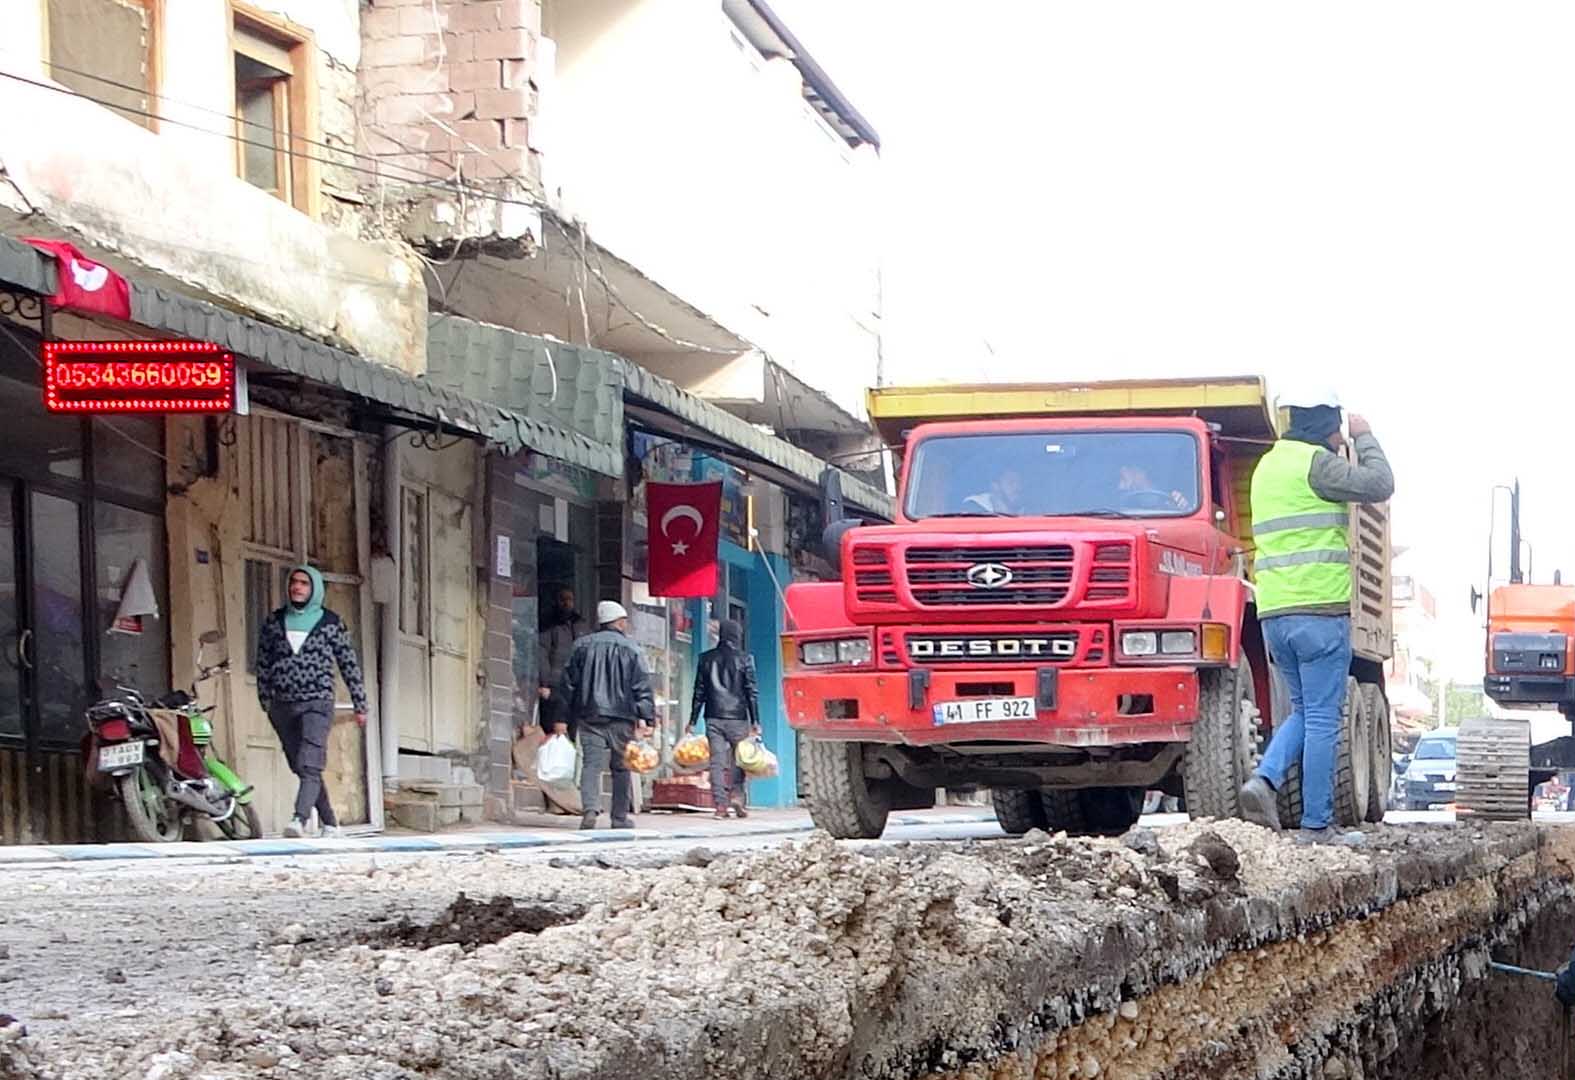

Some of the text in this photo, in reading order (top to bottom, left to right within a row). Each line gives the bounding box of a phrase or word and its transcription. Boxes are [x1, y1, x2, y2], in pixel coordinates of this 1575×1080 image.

[55, 362, 222, 387] 05343660059
[910, 639, 1076, 657] DESOTO
[946, 700, 1030, 720] 41 FF 922
